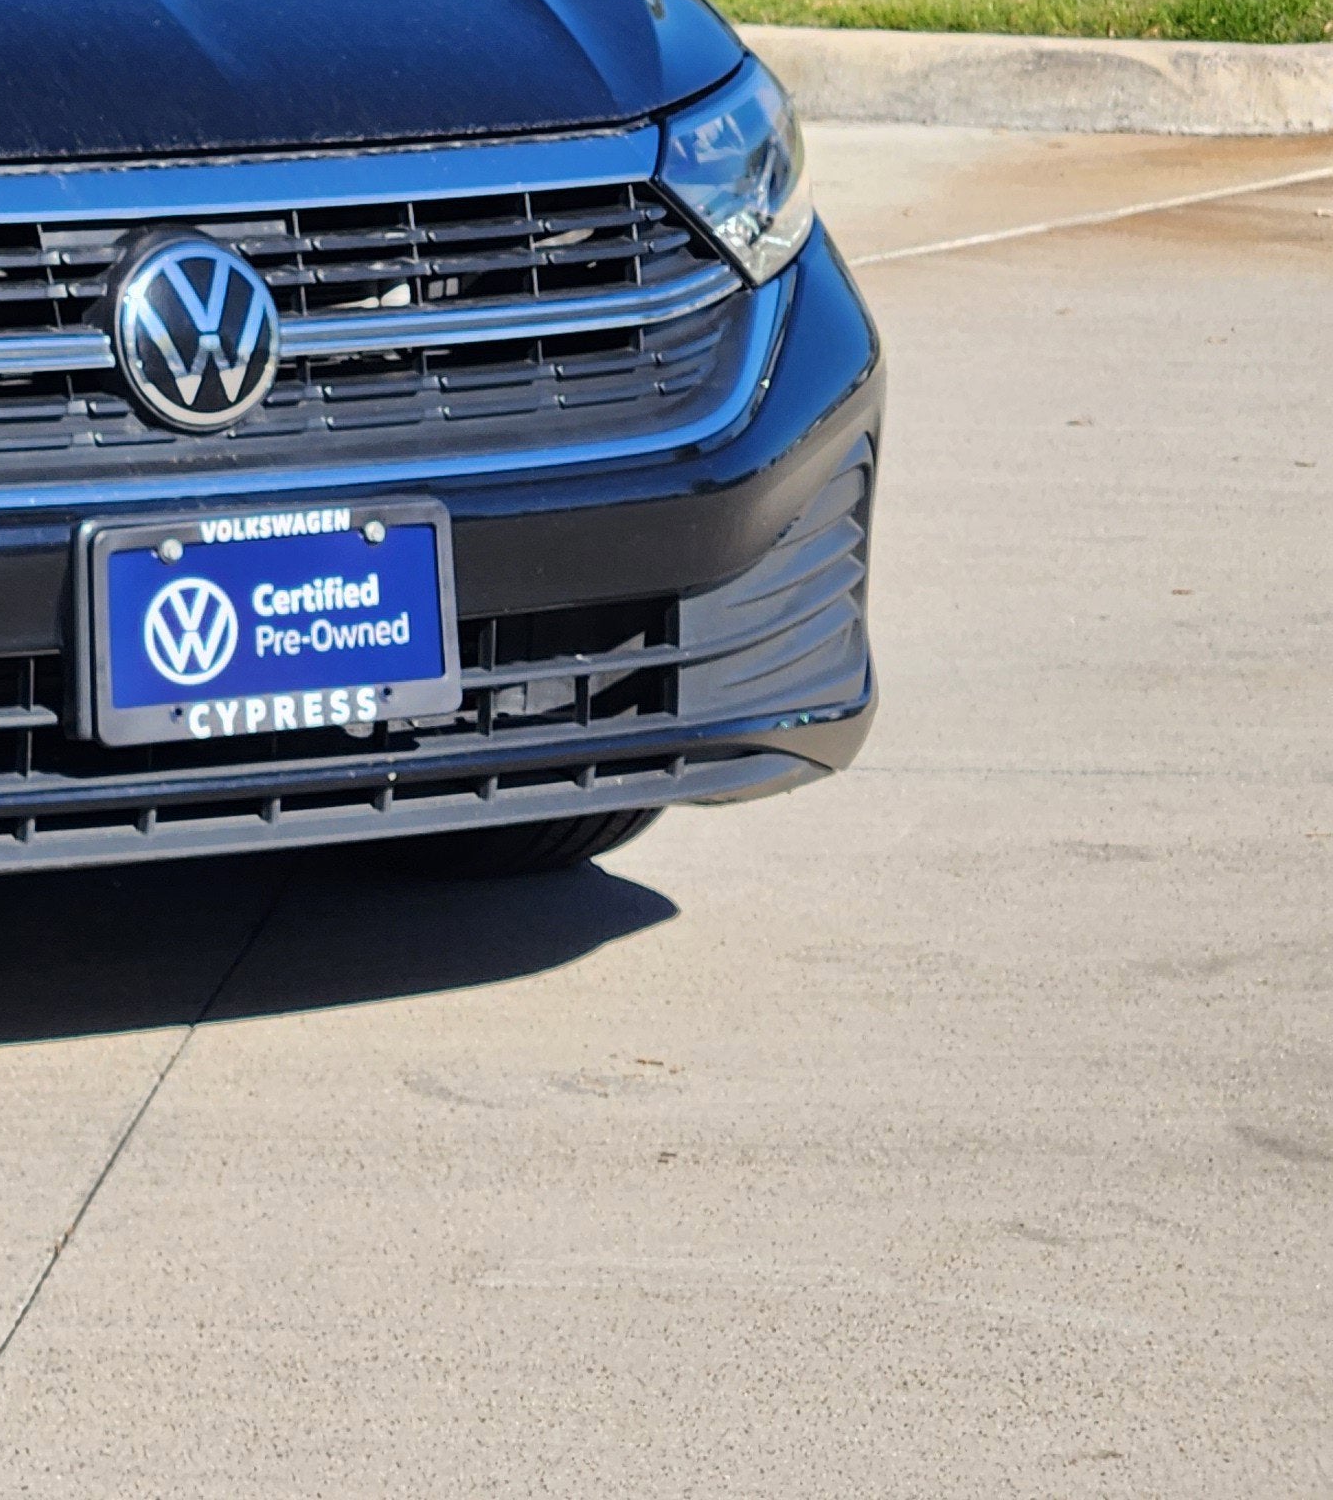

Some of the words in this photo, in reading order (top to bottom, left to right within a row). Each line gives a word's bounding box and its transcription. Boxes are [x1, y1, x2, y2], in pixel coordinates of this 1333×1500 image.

[123, 243, 276, 420] VW
[200, 508, 351, 545] VOLKSWAGEN
[253, 572, 380, 617] Certified
[147, 580, 236, 681] VW
[255, 612, 410, 658] Pre-Owned
[188, 687, 378, 740] CYPRESS
